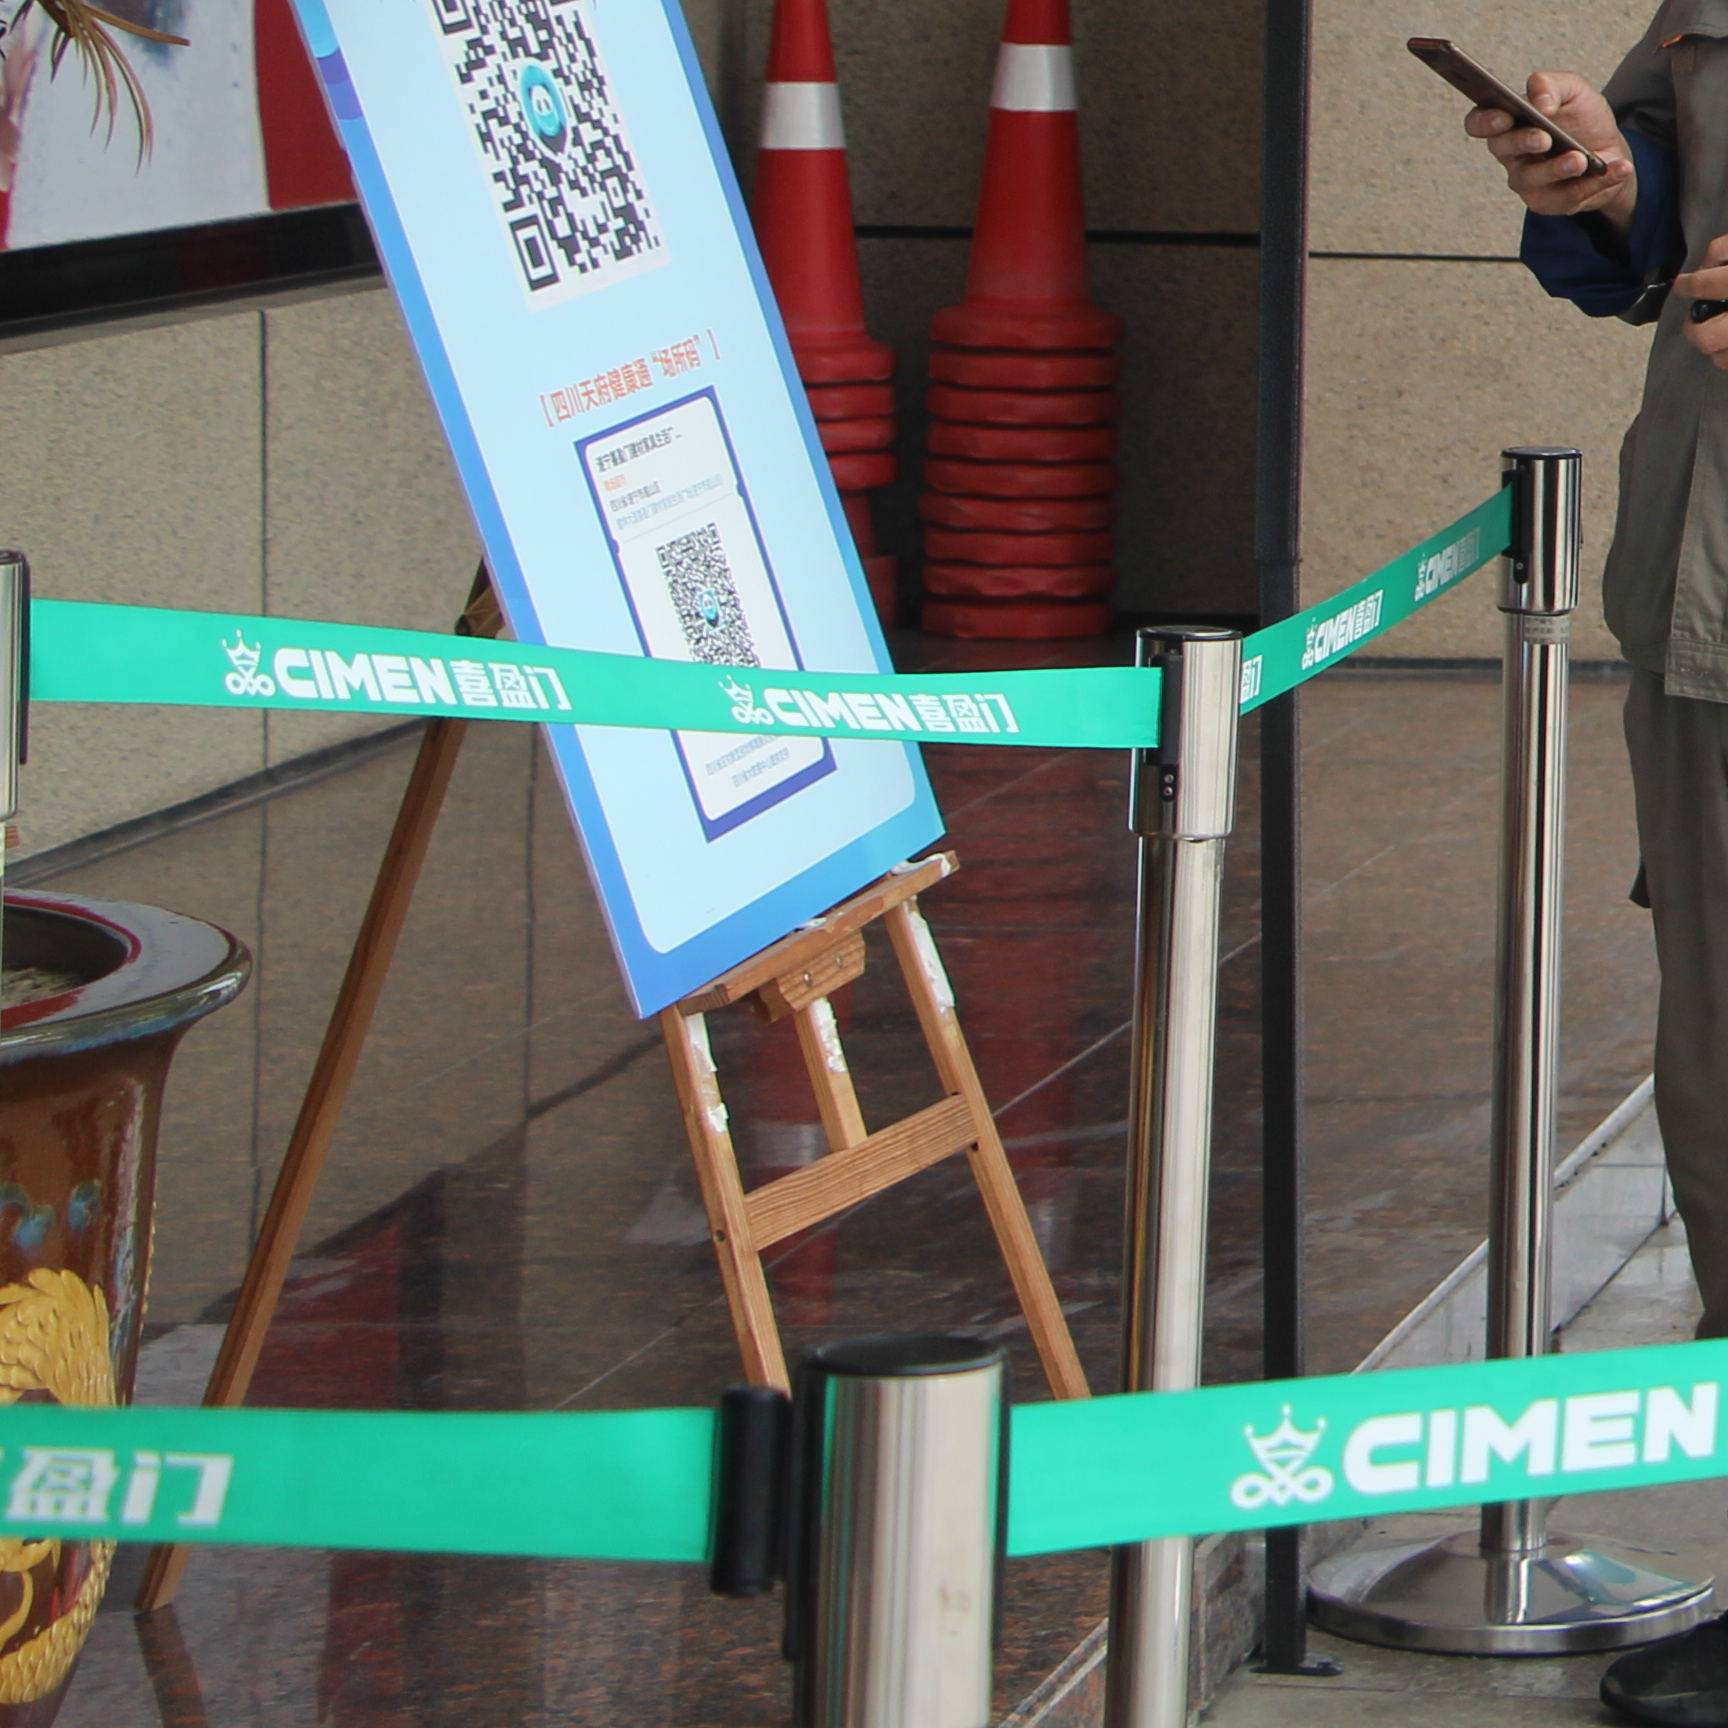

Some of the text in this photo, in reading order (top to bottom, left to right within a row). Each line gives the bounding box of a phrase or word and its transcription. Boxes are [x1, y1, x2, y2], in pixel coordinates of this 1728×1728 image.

[1315, 603, 1355, 663] CIMEN
[273, 647, 573, 712] CIMEN 喜盈门
[762, 688, 1021, 734] CIMEN 喜盈门
[1341, 1383, 1719, 1496] CIMEN
[0, 1445, 234, 1528] 盈门
